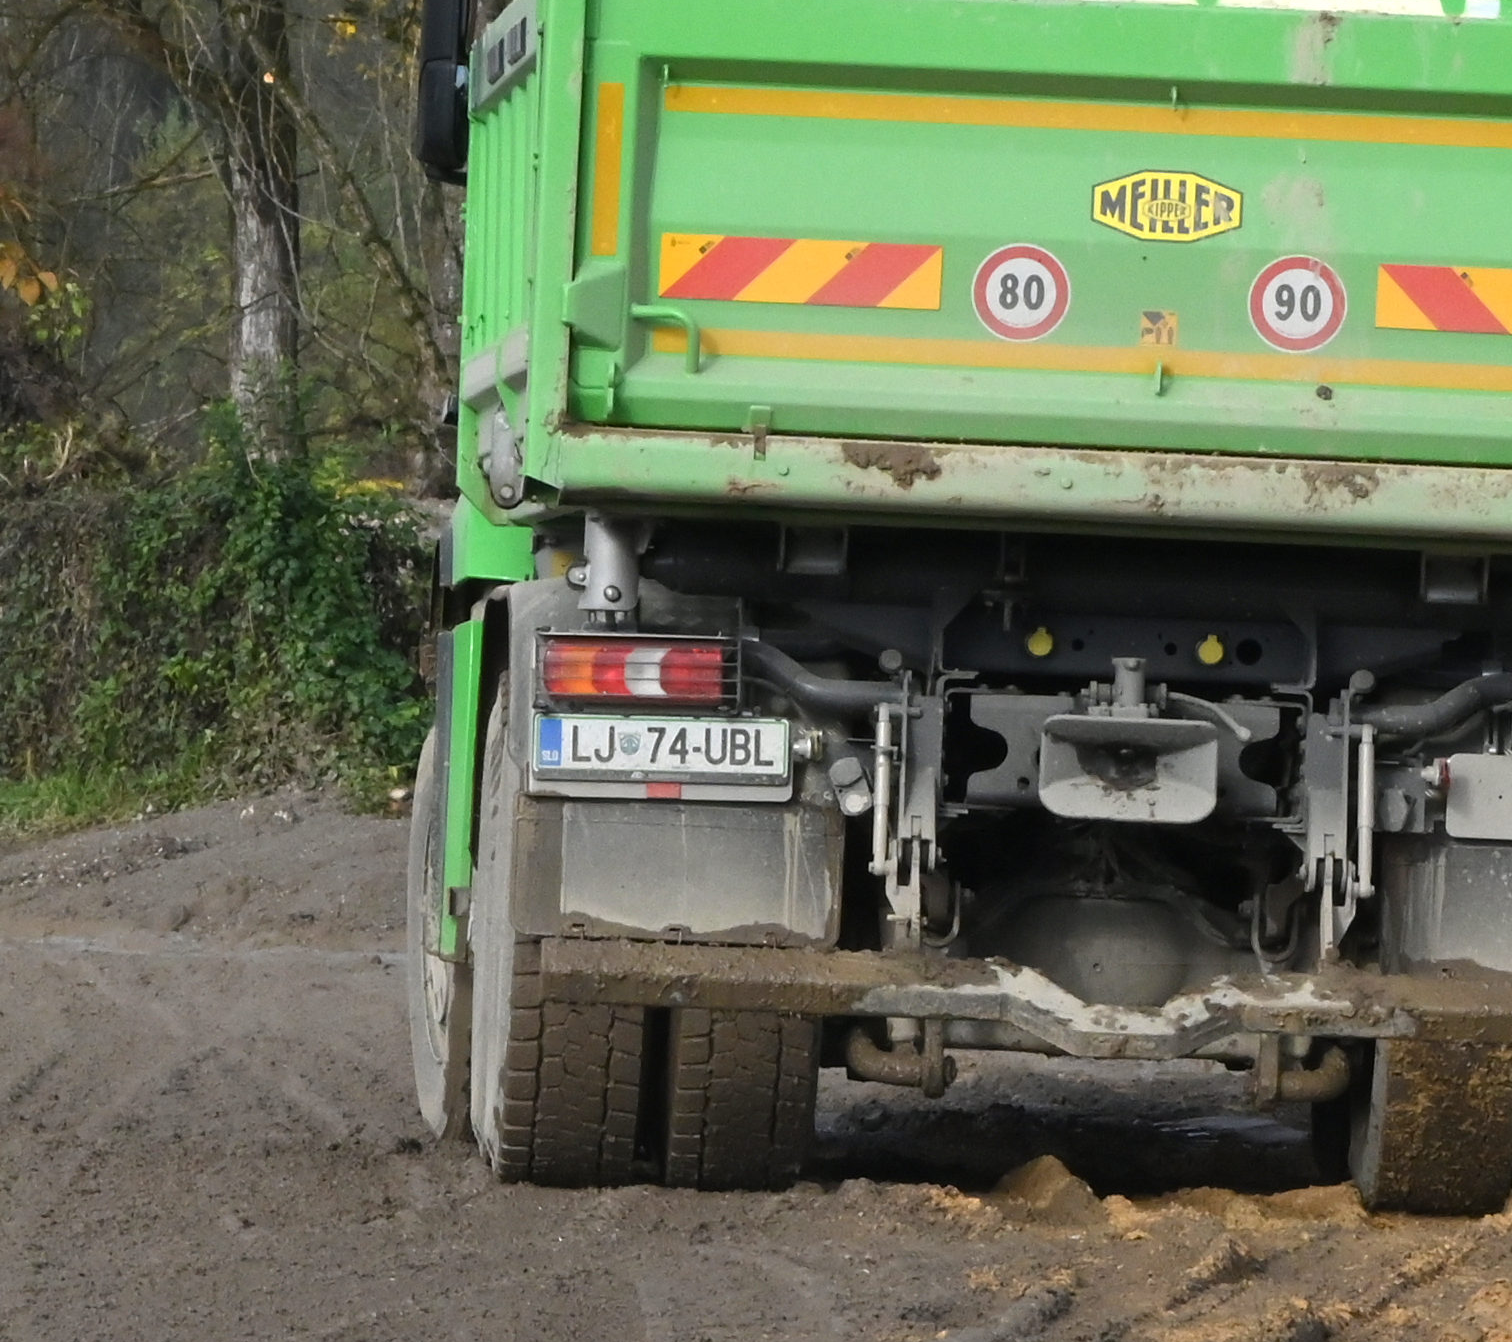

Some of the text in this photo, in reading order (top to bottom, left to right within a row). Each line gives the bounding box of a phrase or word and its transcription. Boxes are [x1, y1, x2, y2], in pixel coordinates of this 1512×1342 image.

[1100, 178, 1235, 234] MEILLER
[998, 273, 1045, 311] 80
[1274, 283, 1322, 322] 90
[571, 725, 775, 768] LJ 74-UBL
